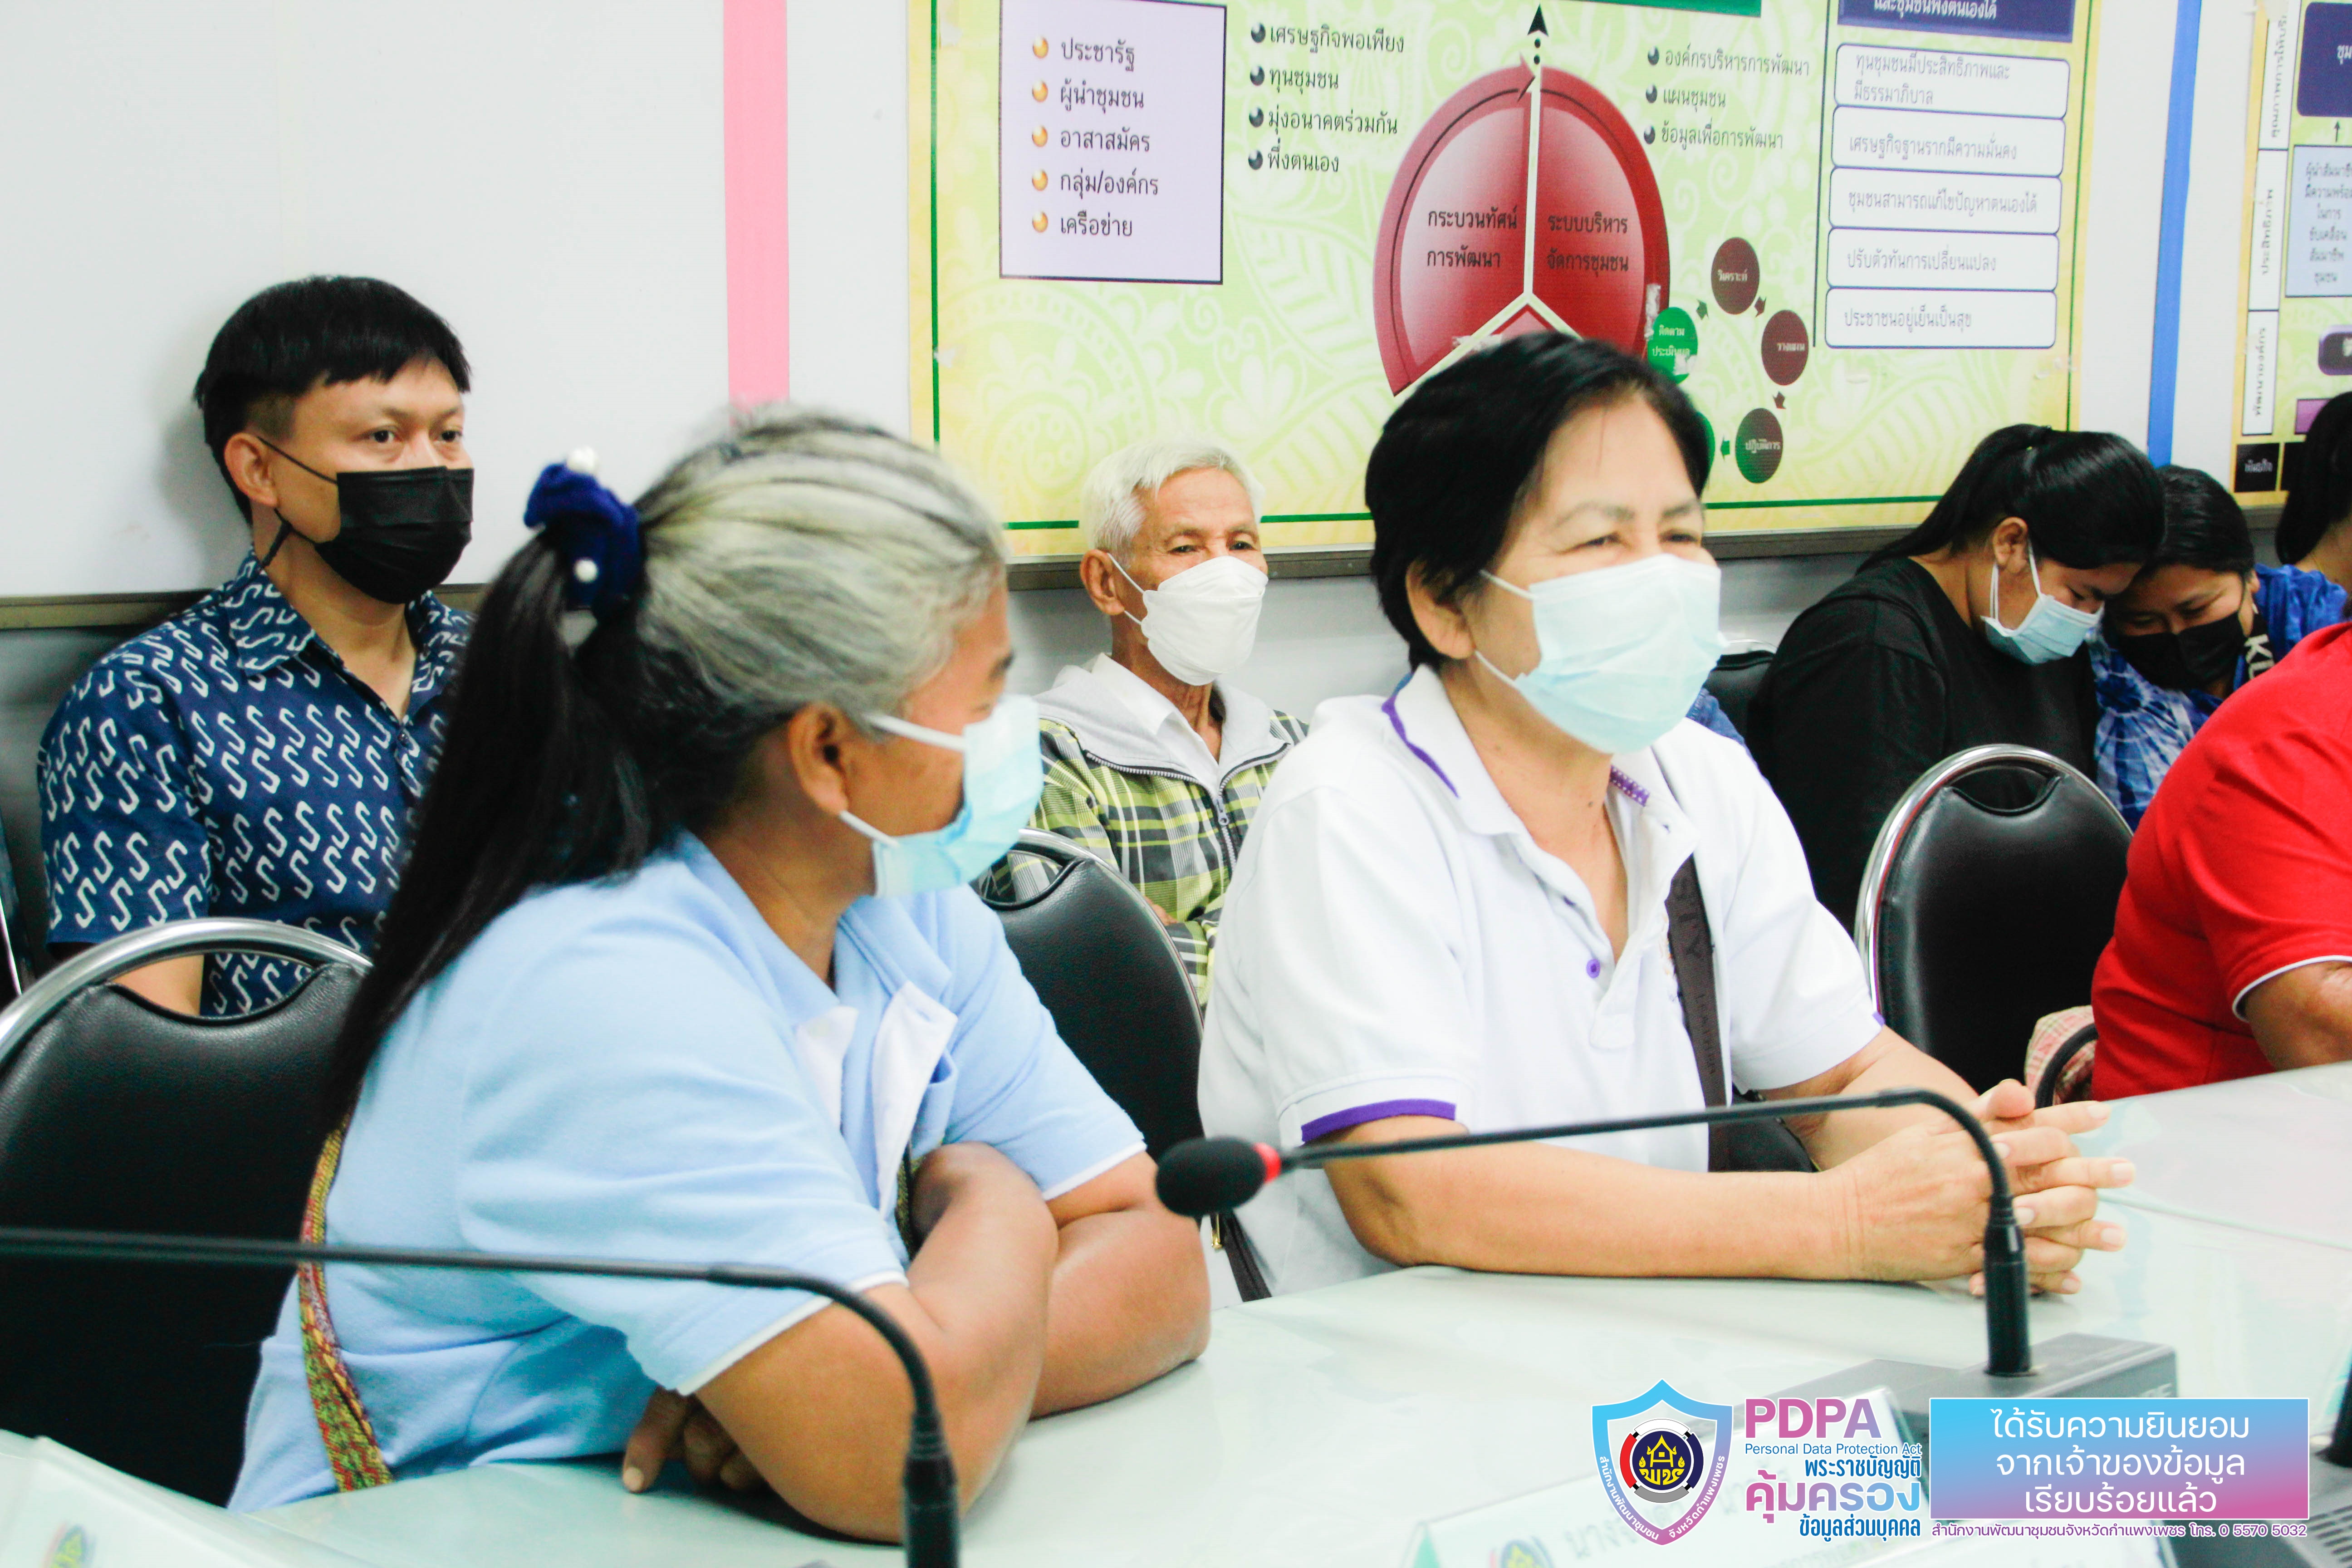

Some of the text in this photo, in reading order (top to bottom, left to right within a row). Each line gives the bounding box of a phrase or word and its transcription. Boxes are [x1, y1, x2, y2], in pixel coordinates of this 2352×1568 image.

[1270, 24, 1405, 54] เศรษฐกิจพอเพียง
[1061, 38, 1135, 71] ประชารัฐ
[1666, 43, 1810, 76] องค์กรบริหารการพัฒนา
[1856, 50, 2010, 79] ทุนชุมชนมีประสิทธิภาพและ
[1269, 67, 1339, 94] ทุนชุมชน
[1059, 79, 1144, 113] ผู้นำชุมชน
[1663, 88, 1726, 113] แผนชุมชน
[1269, 105, 1398, 135] มุ่งอนาคตร่วมกัน
[1661, 118, 1784, 151] ข้อมูลเพื่อการพัฒนา
[1060, 128, 1151, 152] อาสาสมัคร
[1267, 138, 1340, 173] พึ่งตนเอง
[1060, 167, 1159, 200] กลุ่ม/องค์กร
[1060, 211, 1133, 236] เครือข่าย
[1428, 205, 1518, 229] กระบวนทัศน์
[1548, 210, 1628, 234] ระบบบริหาร
[1427, 247, 1501, 269] การพัฒนา
[1547, 250, 1629, 279] จัดการชุมชน
